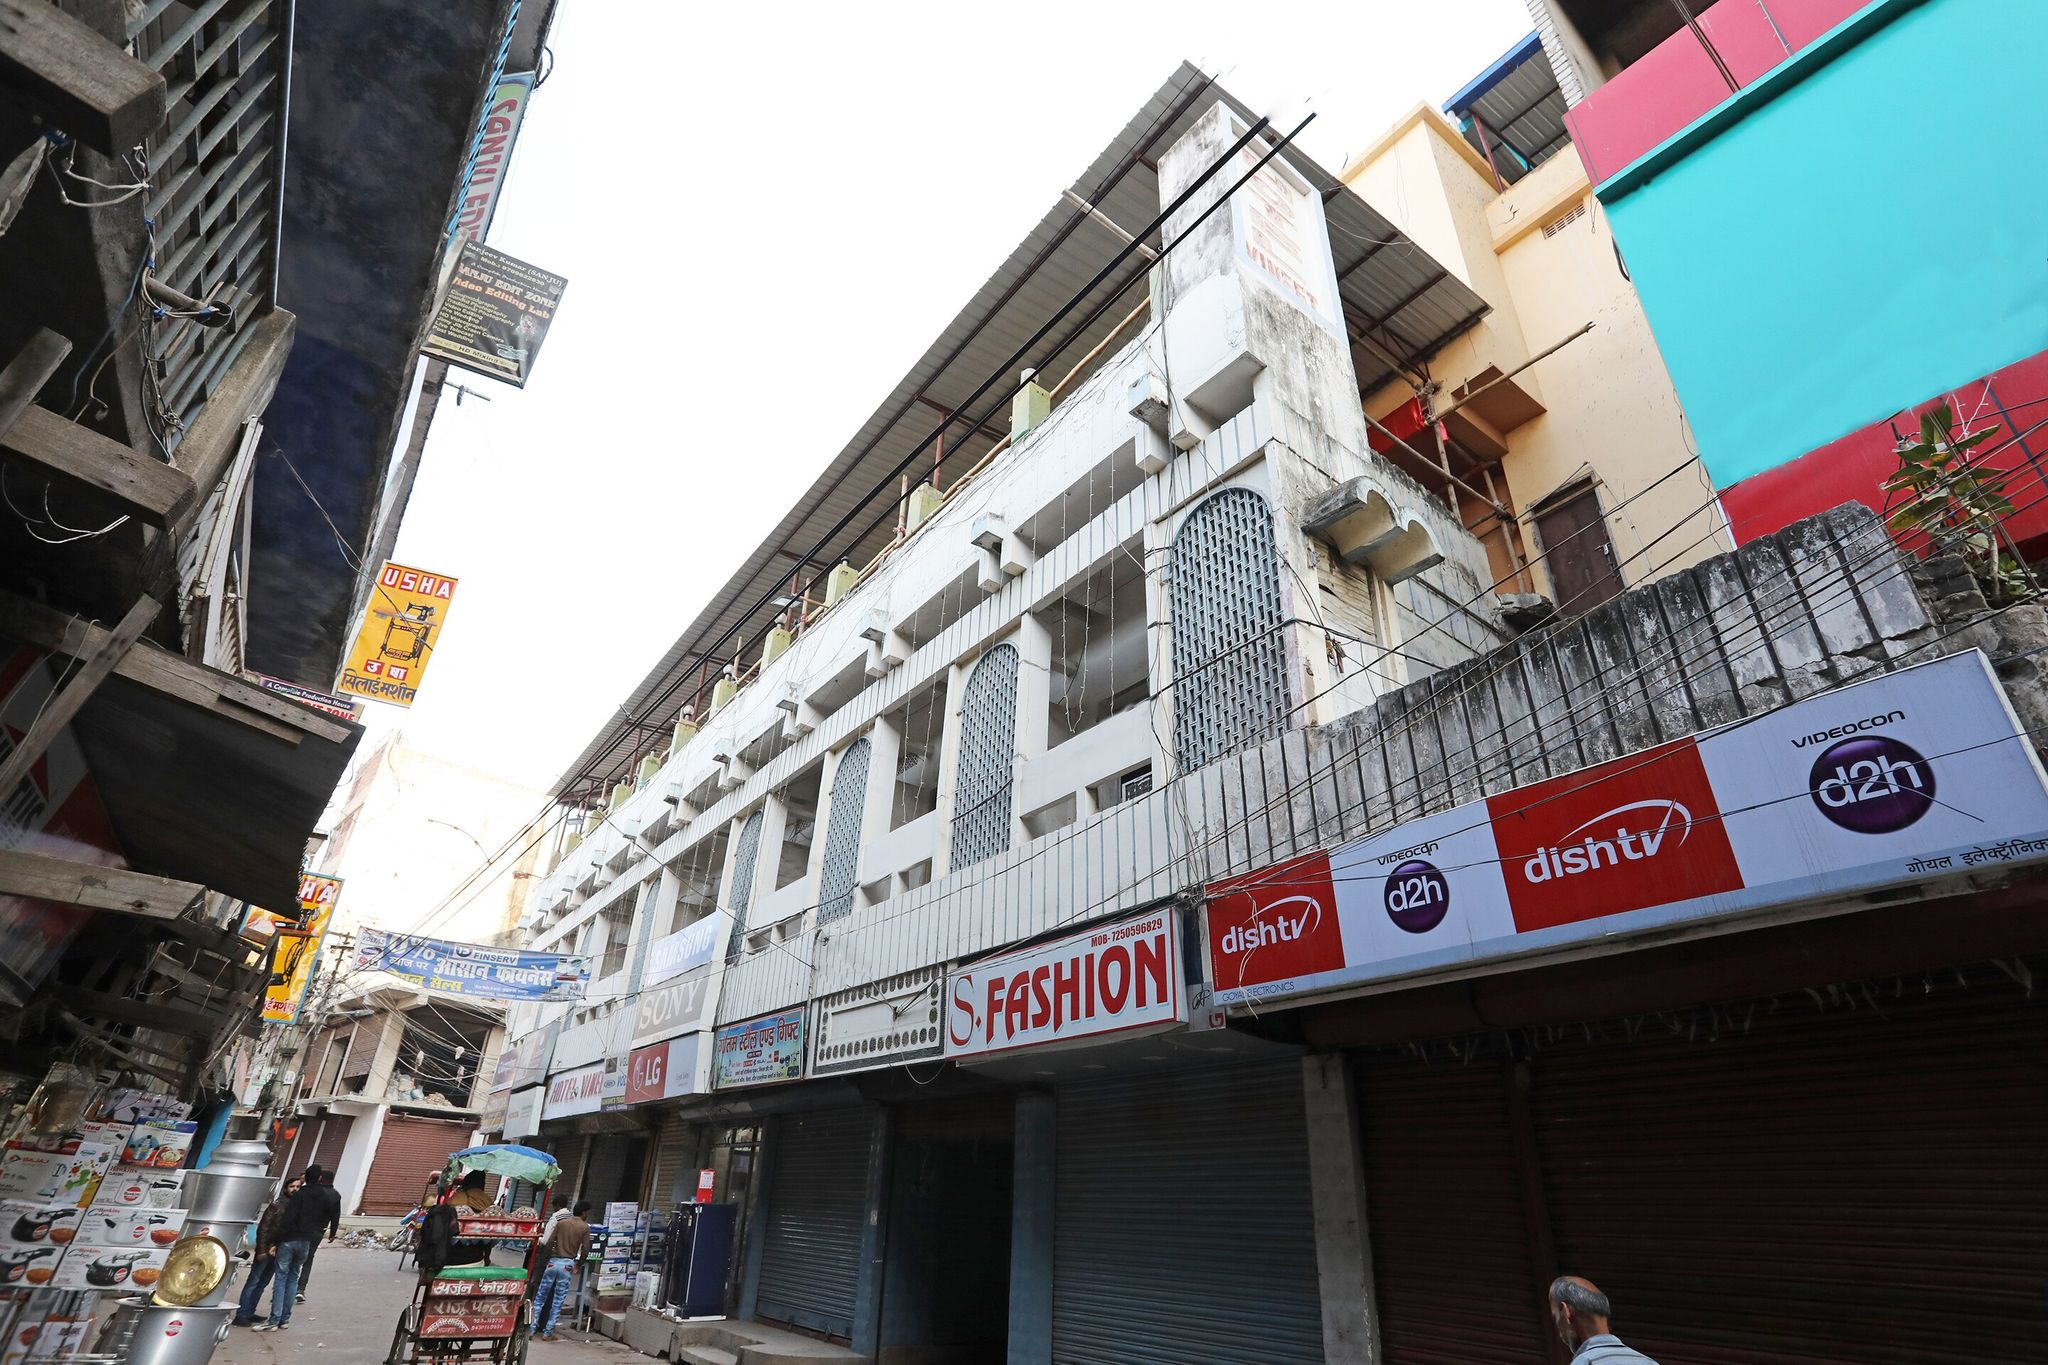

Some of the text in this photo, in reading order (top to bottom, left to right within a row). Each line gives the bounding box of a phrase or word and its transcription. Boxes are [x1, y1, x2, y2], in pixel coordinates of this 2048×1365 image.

[498, 256, 527, 271] Kumar
[483, 286, 528, 311] Editing
[527, 304, 551, 319] Lab
[523, 291, 556, 309] ZONE
[385, 568, 452, 598] USHA
[301, 690, 333, 704] Production
[331, 699, 351, 709] House
[382, 682, 418, 702] मशीन
[1791, 709, 1906, 748] VIDEOCON
[1819, 755, 1923, 809] d2h
[1377, 842, 1439, 866] VIDEOCON
[1524, 797, 1678, 885] dishtv
[1906, 858, 1952, 873] गोयल
[1388, 876, 1443, 913] d2h
[1221, 899, 1313, 954] dishtv
[474, 950, 517, 965] FINSERV
[651, 926, 711, 967] SAMSUNG
[640, 981, 702, 1029] SONY
[645, 1056, 662, 1087] LG
[110, 1164, 138, 1174] Hawkins
